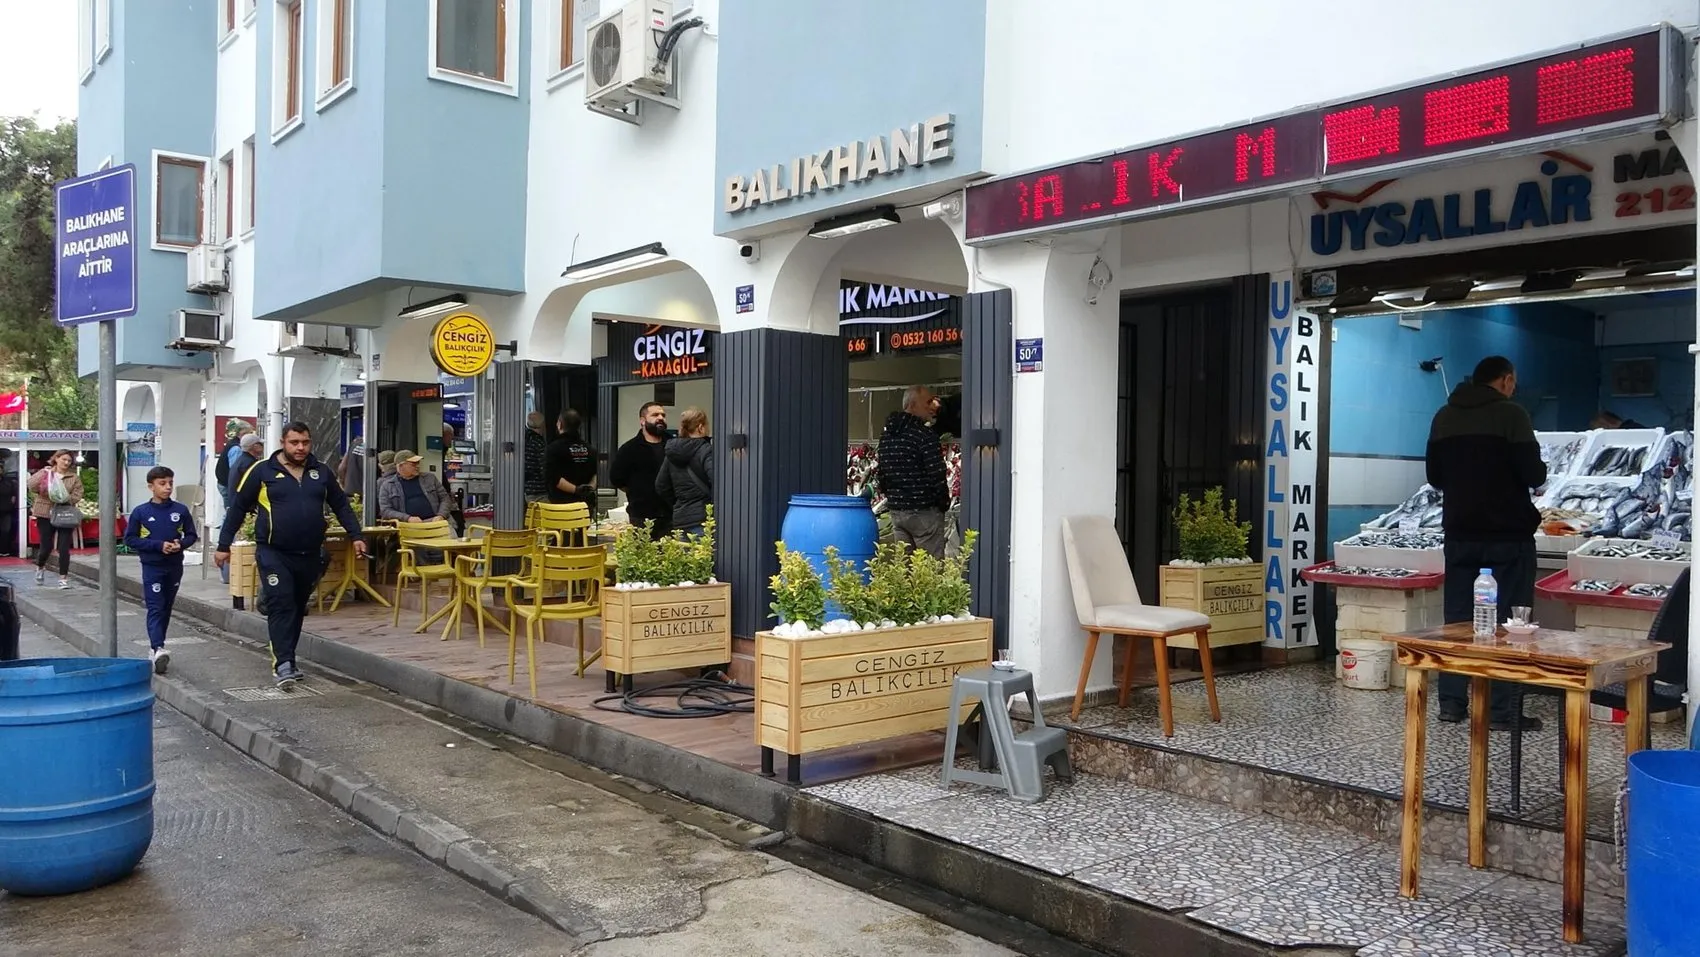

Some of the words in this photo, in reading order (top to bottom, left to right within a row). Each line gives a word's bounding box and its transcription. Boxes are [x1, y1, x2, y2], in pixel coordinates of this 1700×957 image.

[725, 113, 956, 214] BALIKHANE
[1615, 184, 1696, 218] 212
[66, 206, 125, 233] BALIKHANE
[1310, 174, 1593, 256] UYSALLAR
[62, 230, 129, 258] ARAÇLARINA
[78, 255, 112, 278] AİTTİR
[443, 330, 487, 344] CENGİZ
[444, 343, 486, 354] BALIKÇILIK
[633, 327, 706, 362] CENGİZ
[902, 331, 925, 346] 0532
[927, 329, 944, 344] 160
[946, 328, 958, 341] 56
[641, 355, 698, 378] KARAGÜL
[1293, 316, 1314, 451] BALIK
[1265, 281, 1291, 640] UYSALLAR
[1291, 484, 1312, 643] MARKET
[648, 604, 710, 620] CENGİZ
[855, 649, 945, 674] CENGİZ
